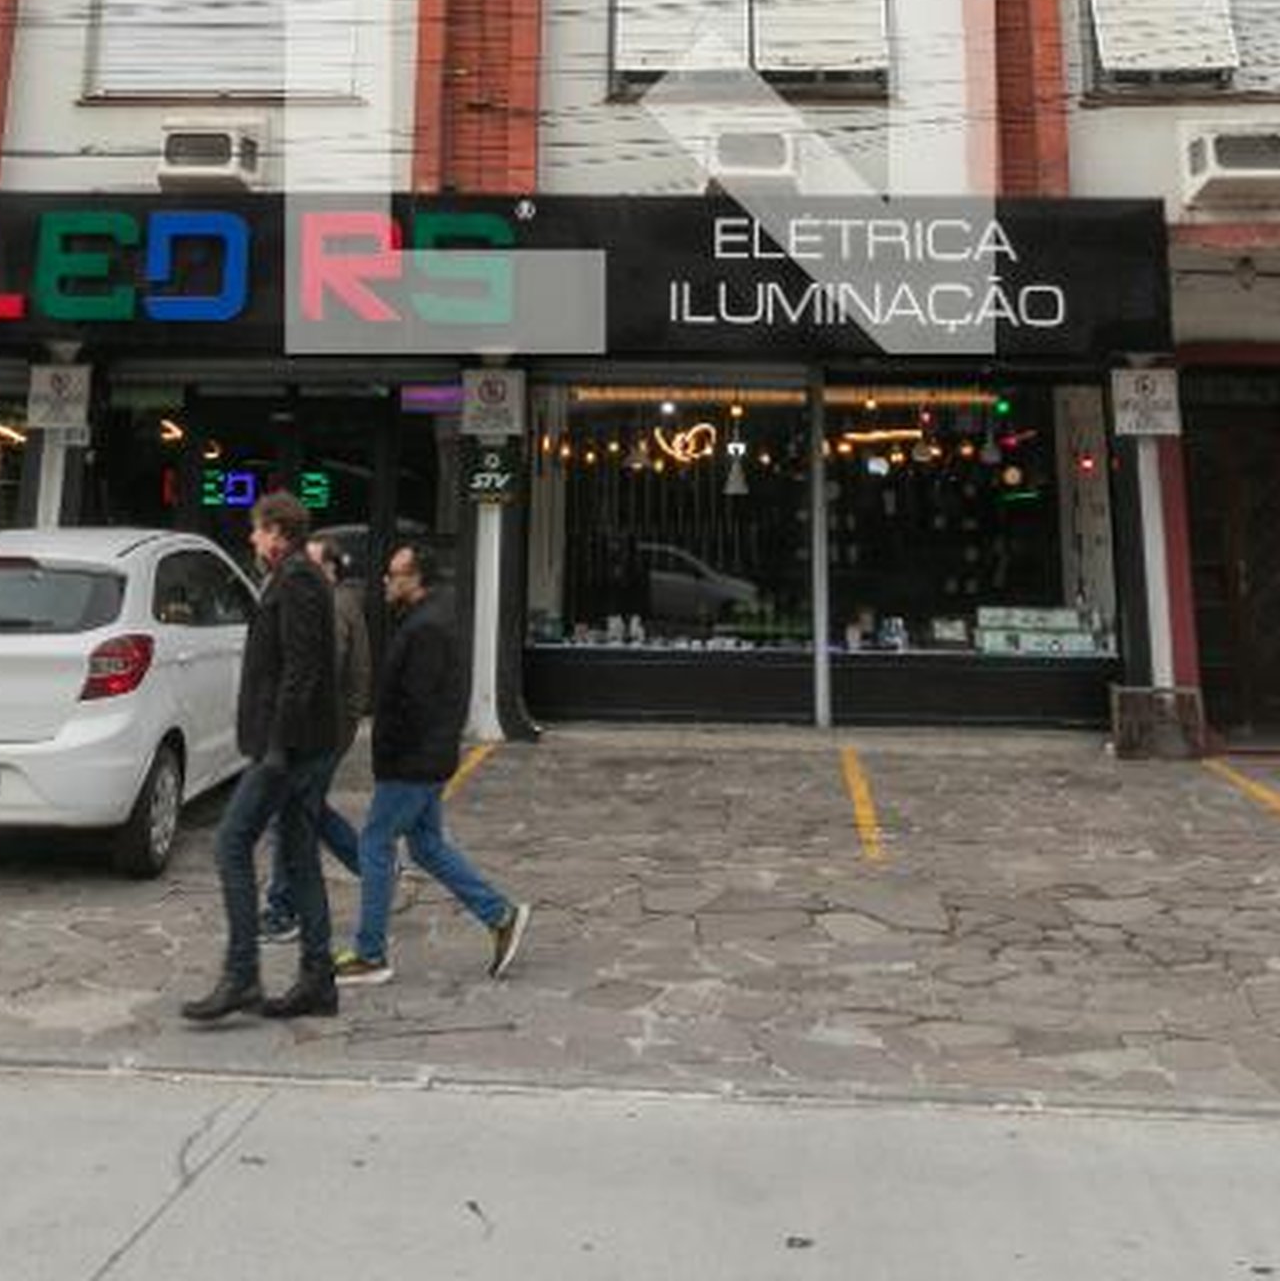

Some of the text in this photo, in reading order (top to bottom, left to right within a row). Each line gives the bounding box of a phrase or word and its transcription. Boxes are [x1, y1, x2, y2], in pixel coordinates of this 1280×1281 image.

[299, 212, 517, 323] RS
[670, 276, 1065, 332] ILUMINAÇÃO
[470, 472, 511, 489] STV
